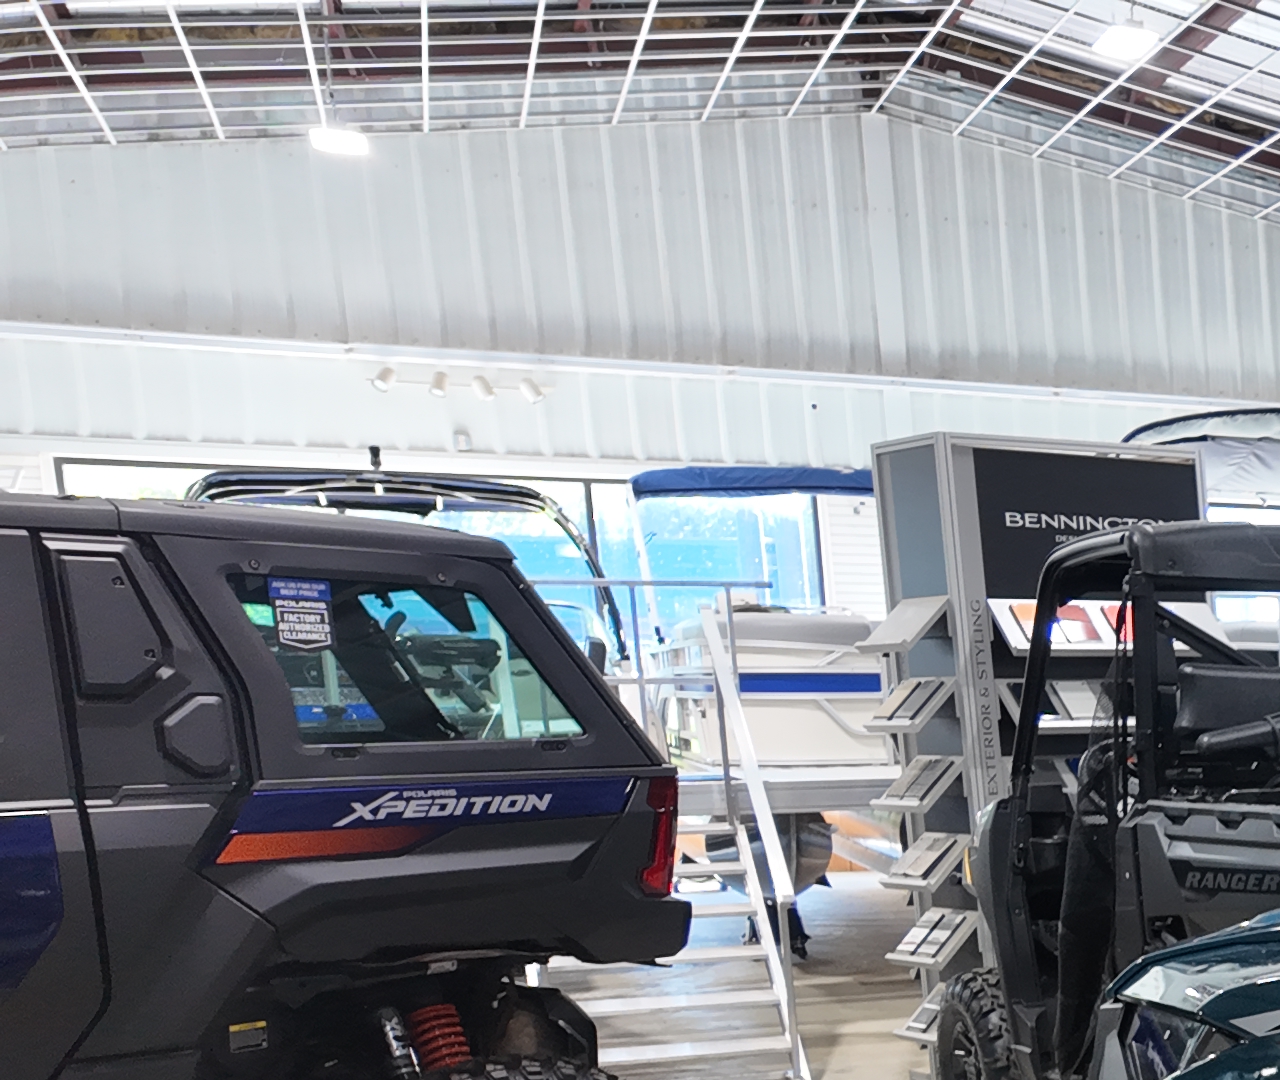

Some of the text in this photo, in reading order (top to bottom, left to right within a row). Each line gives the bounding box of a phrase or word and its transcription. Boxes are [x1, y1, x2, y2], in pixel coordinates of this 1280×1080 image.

[970, 599, 999, 796] EXTERIOR & STYLING
[403, 789, 457, 798] POLARIS
[332, 791, 553, 827] XPEDITION
[1184, 871, 1280, 891] RANGER
